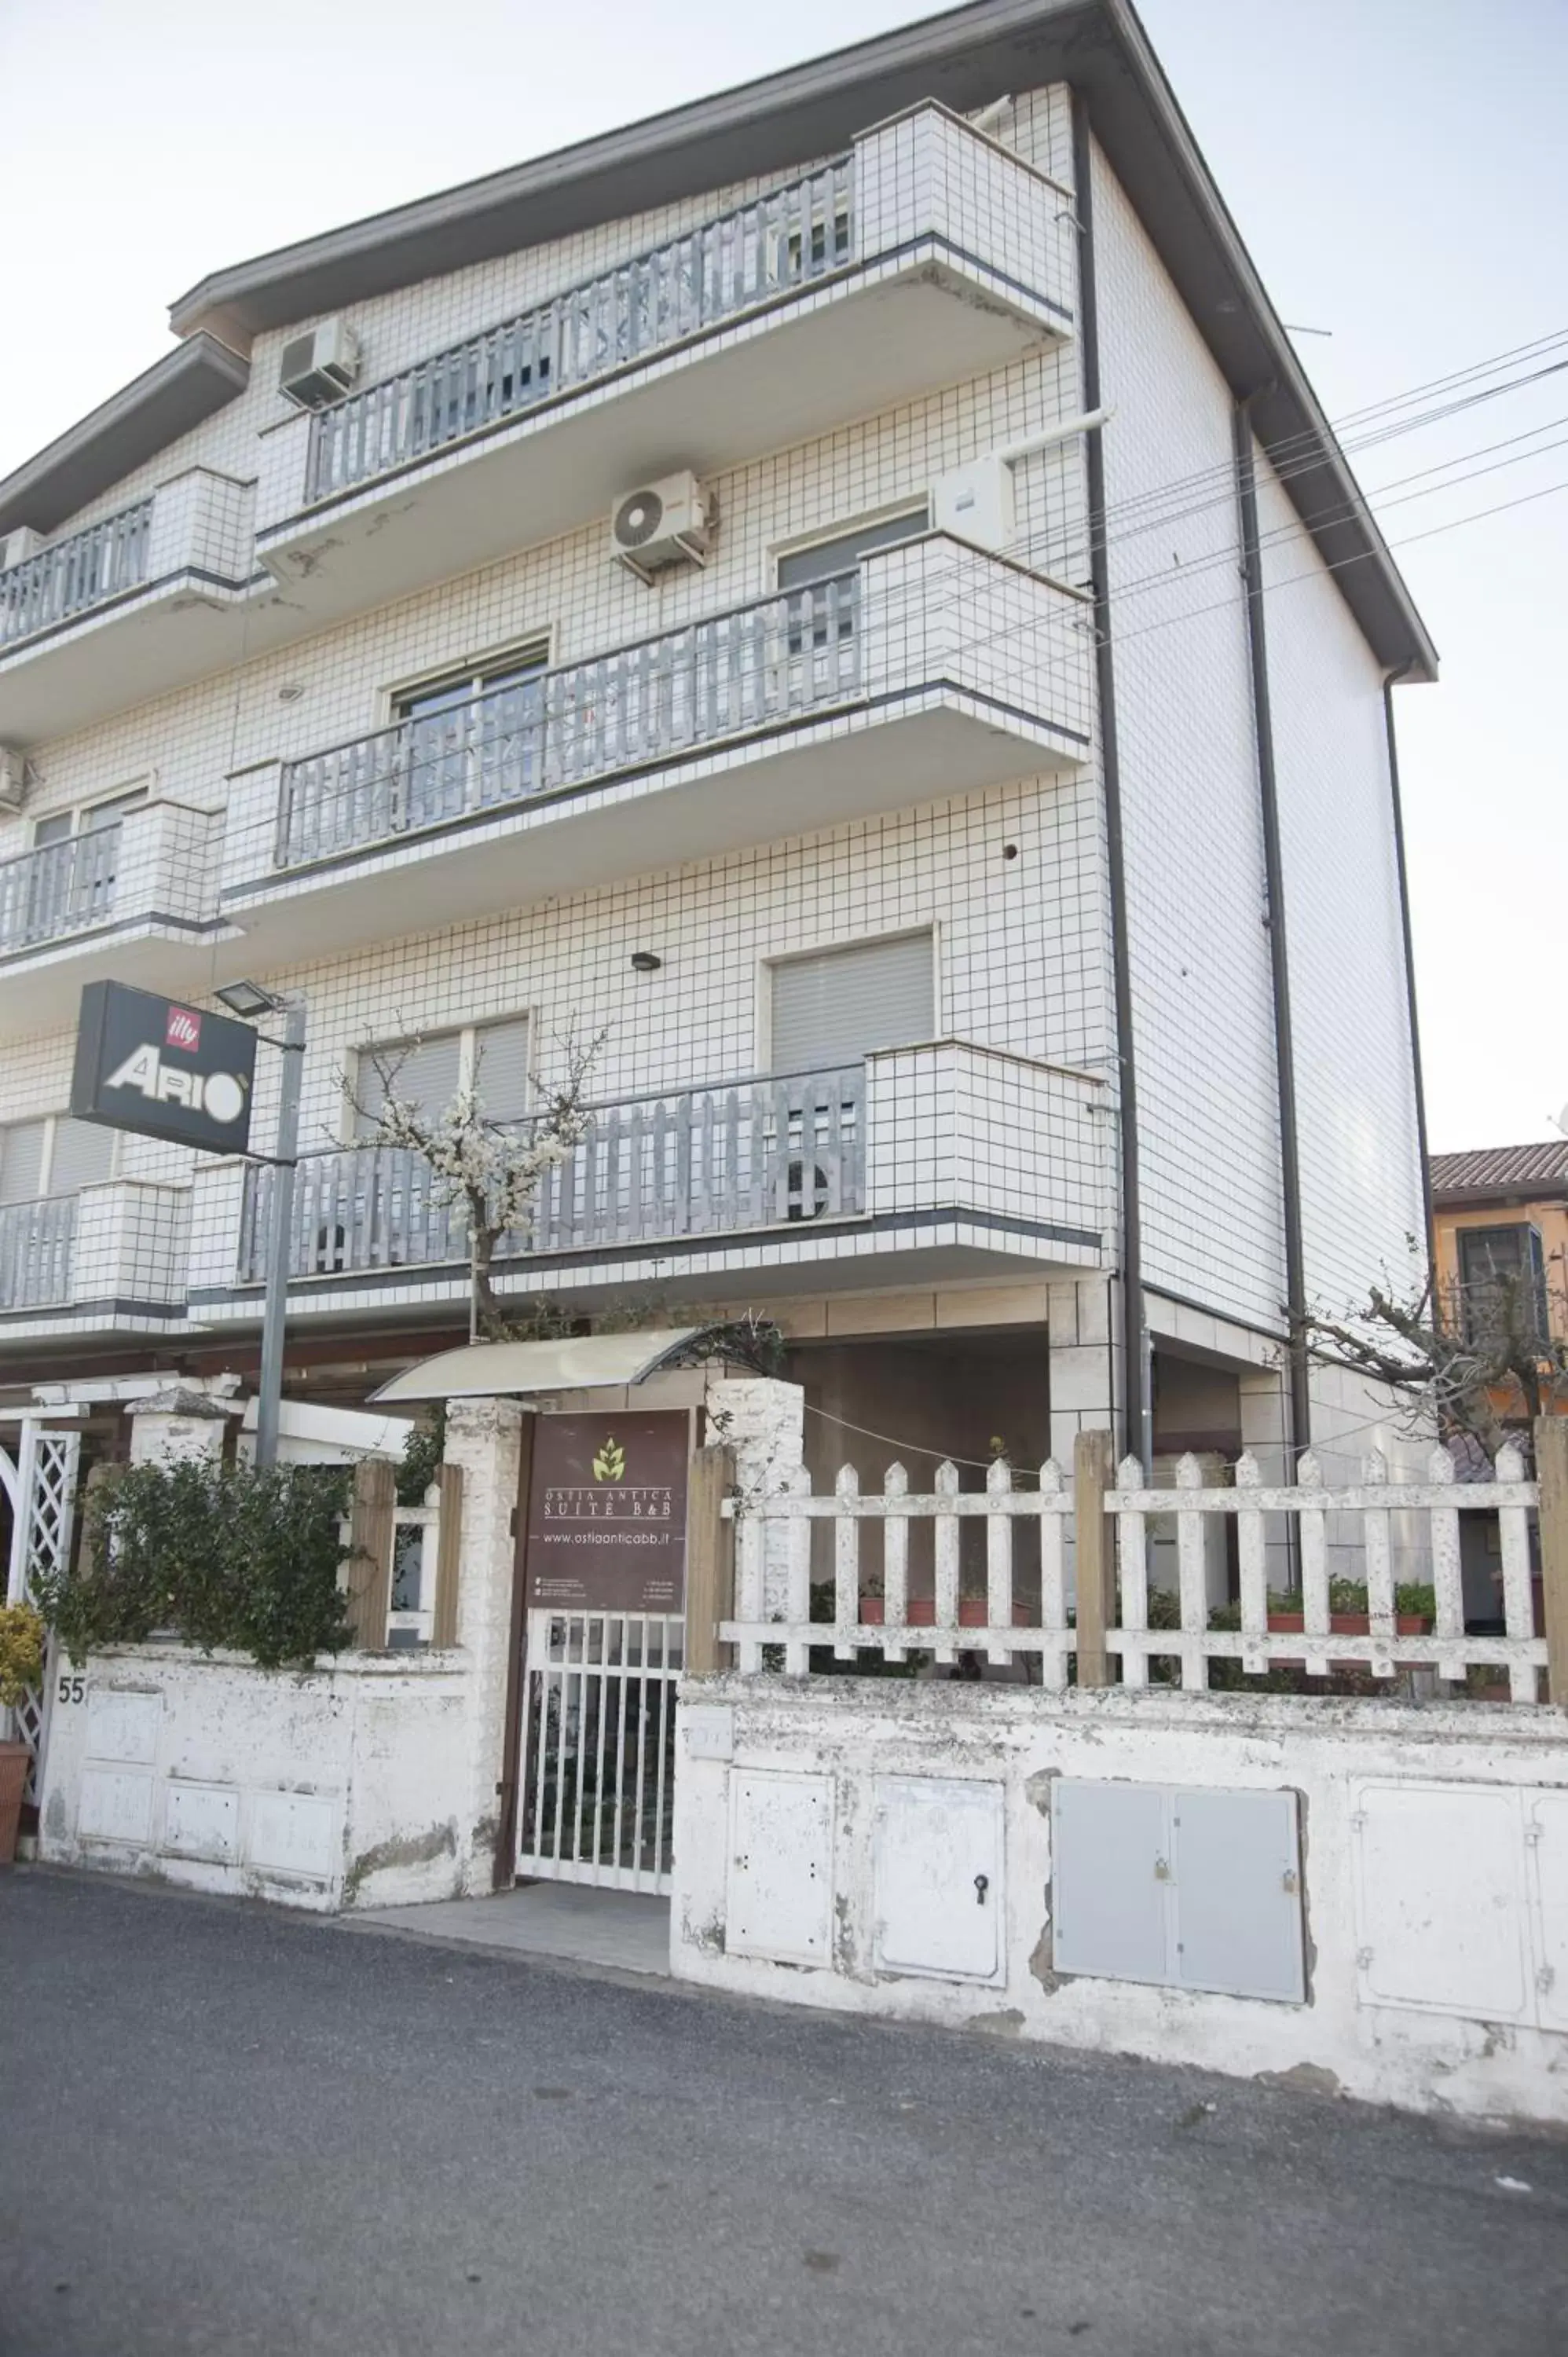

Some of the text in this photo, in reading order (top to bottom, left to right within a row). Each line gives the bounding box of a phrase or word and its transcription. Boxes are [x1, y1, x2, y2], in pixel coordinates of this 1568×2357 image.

[169, 1015, 198, 1044] illy
[545, 1490, 672, 1501] OSTIA ANTICA
[544, 1501, 672, 1516] SUITE B&B
[543, 1531, 669, 1545] www.ostiaanticabb.it
[59, 1677, 86, 1704] 55
